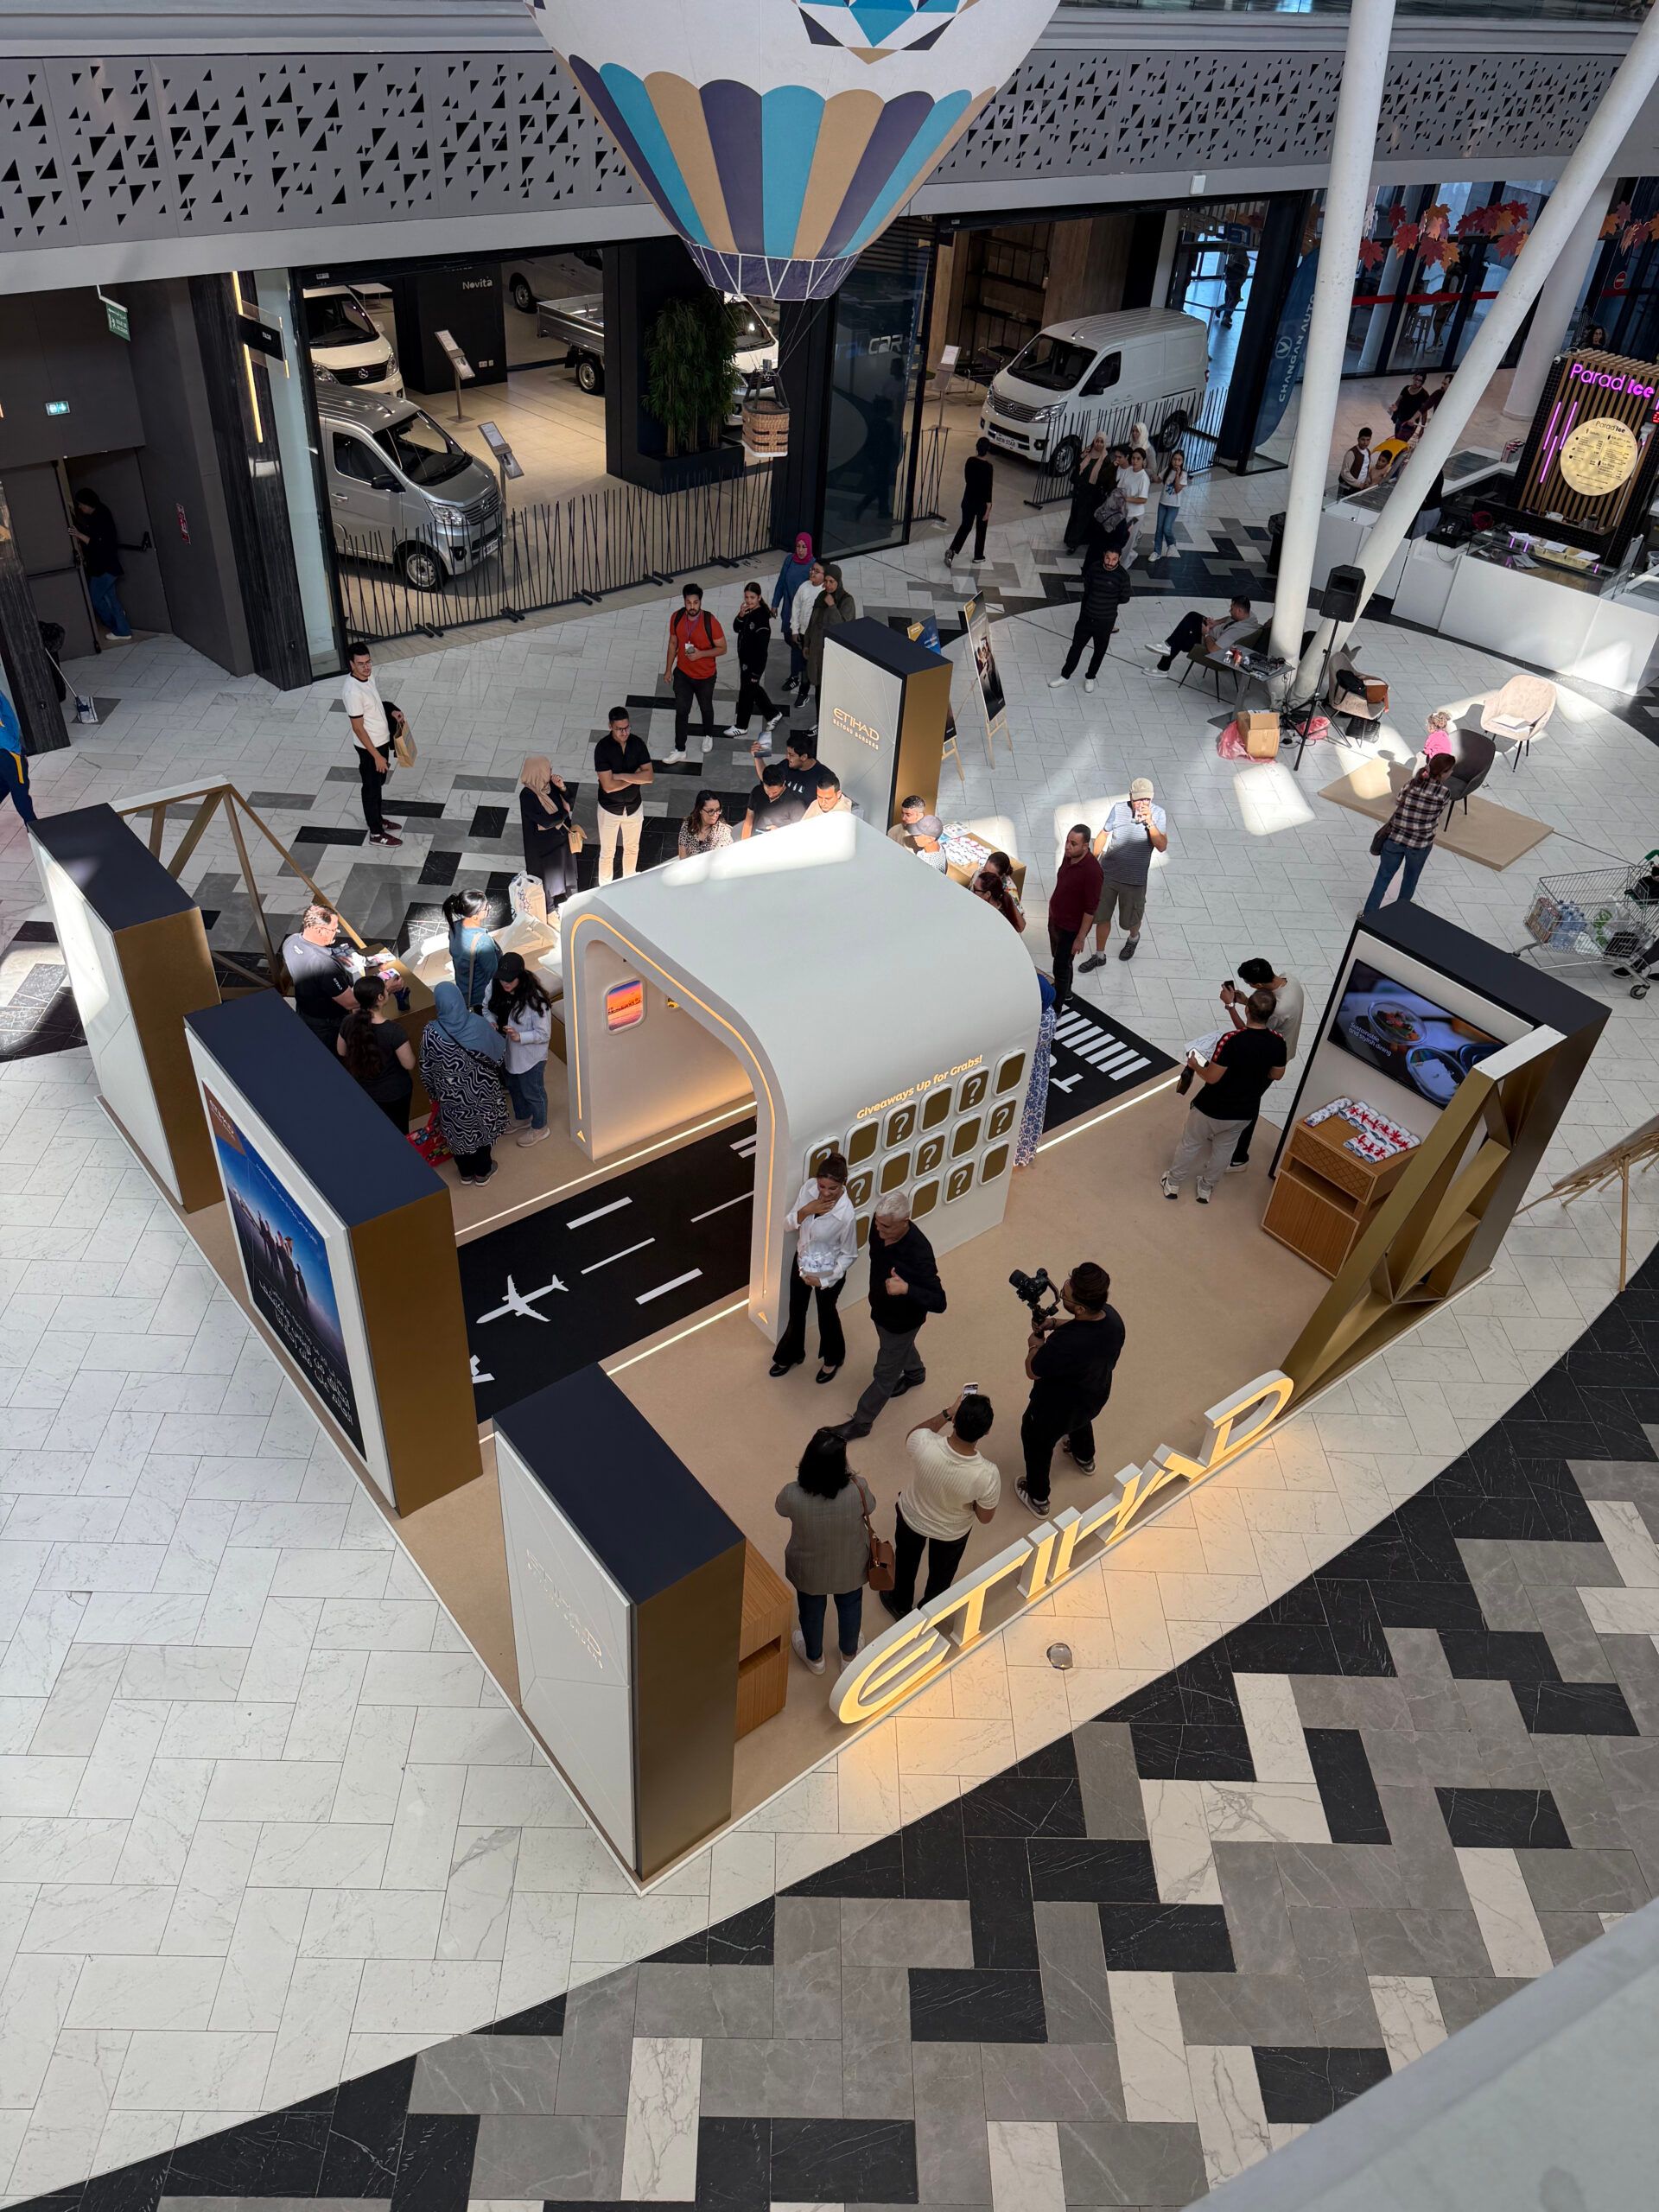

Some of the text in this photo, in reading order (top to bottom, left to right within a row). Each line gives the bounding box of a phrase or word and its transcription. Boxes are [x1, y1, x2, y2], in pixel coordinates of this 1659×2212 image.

[1279, 335, 1304, 403] CHANGAN
[834, 708, 880, 741] ETIHAD
[1348, 1027, 1392, 1056] and stylish dining
[1350, 1022, 1380, 1042] Sustainable
[856, 1054, 983, 1120] Giveaways Up for Grabs!
[830, 1370, 1294, 1724] ETIHAD
